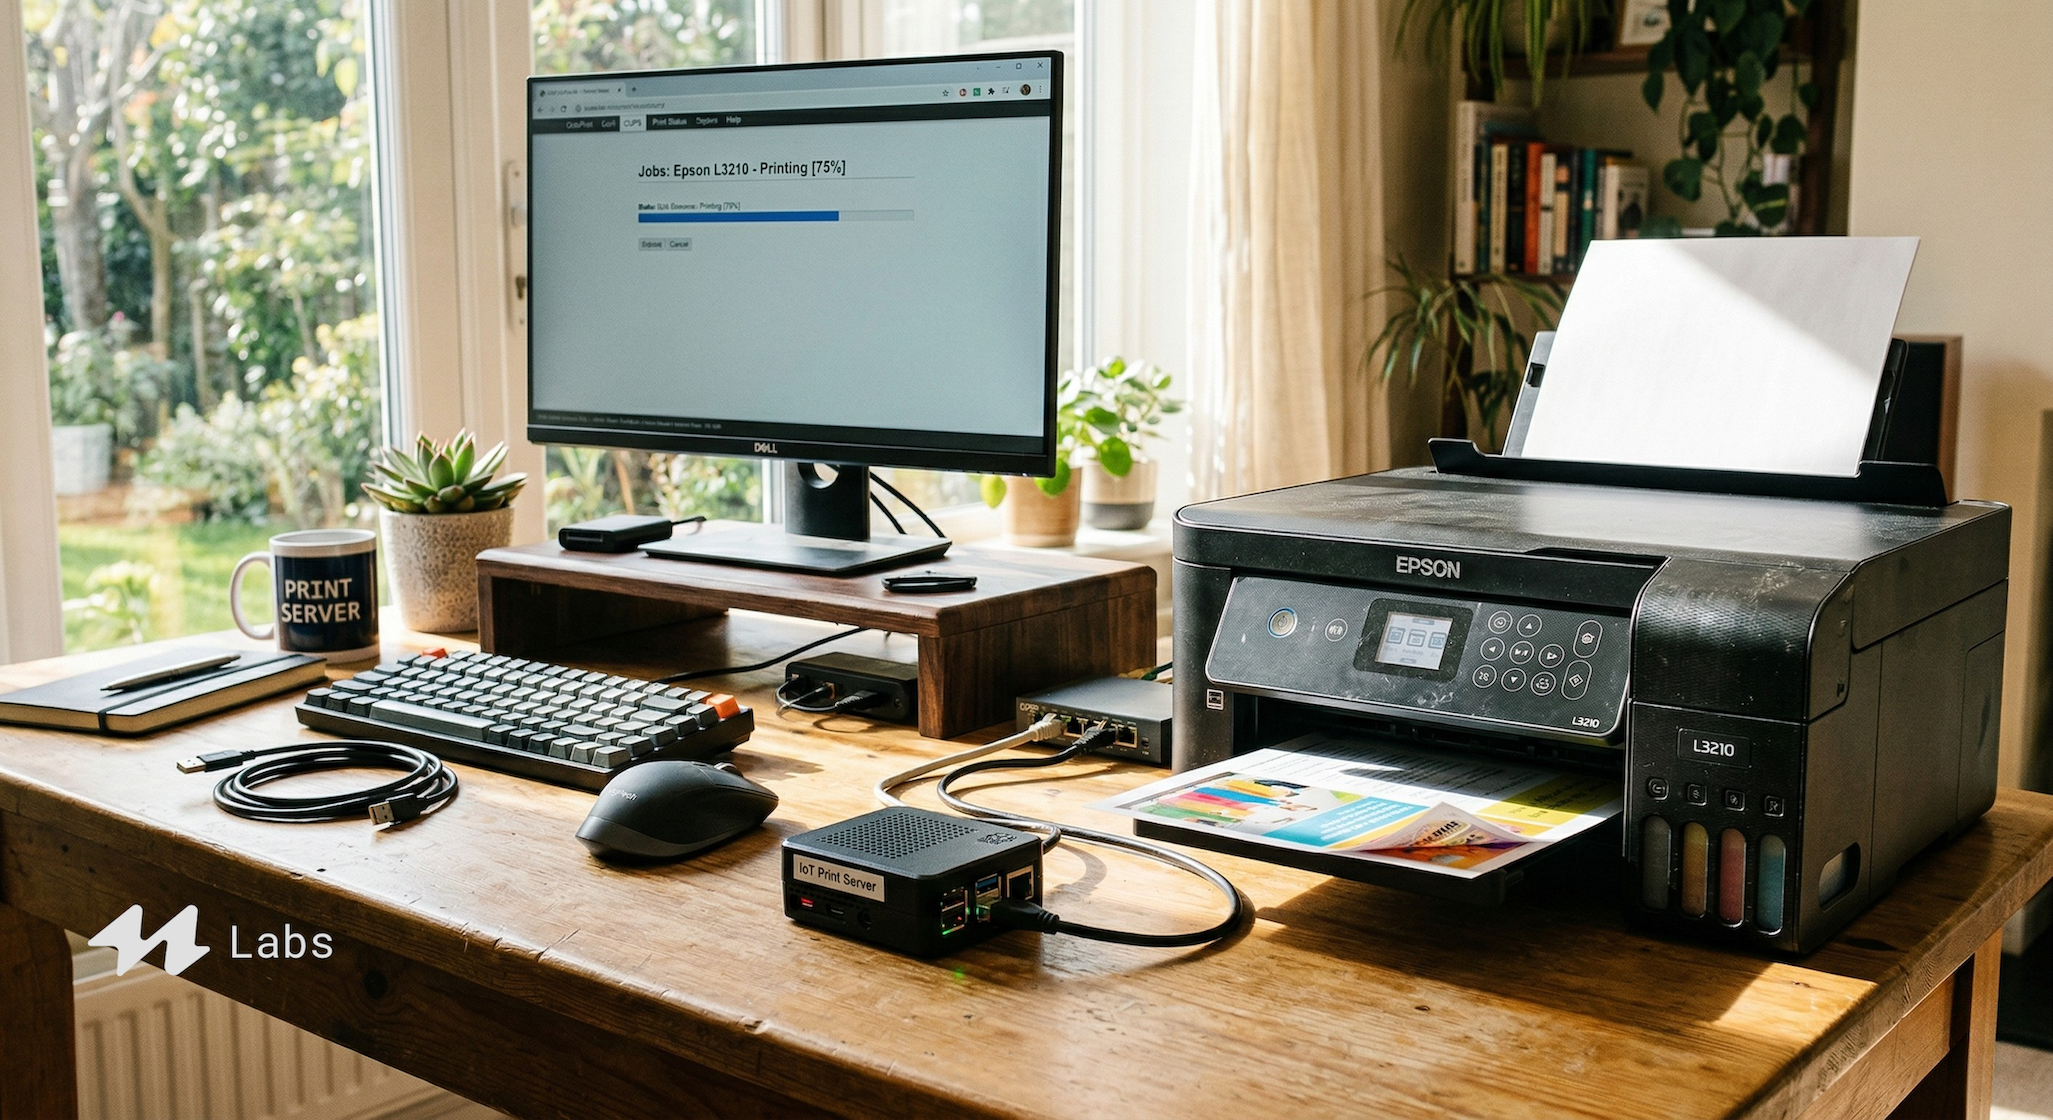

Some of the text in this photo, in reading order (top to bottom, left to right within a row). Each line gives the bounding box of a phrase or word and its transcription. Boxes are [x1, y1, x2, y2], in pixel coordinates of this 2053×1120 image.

[726, 115, 742, 125] Help
[638, 165, 670, 177] Jobs:
[674, 164, 710, 180] Epson
[714, 163, 749, 176] L3210
[760, 161, 808, 177] Printing
[812, 160, 846, 177] [75%]
[754, 442, 778, 454] DELL
[1396, 555, 1460, 579] EPSON
[285, 578, 352, 599] PRINT
[281, 601, 361, 624] SERVER
[1572, 716, 1600, 728] L3210
[1693, 739, 1735, 757] L3210
[799, 862, 877, 892] IoT Print Server
